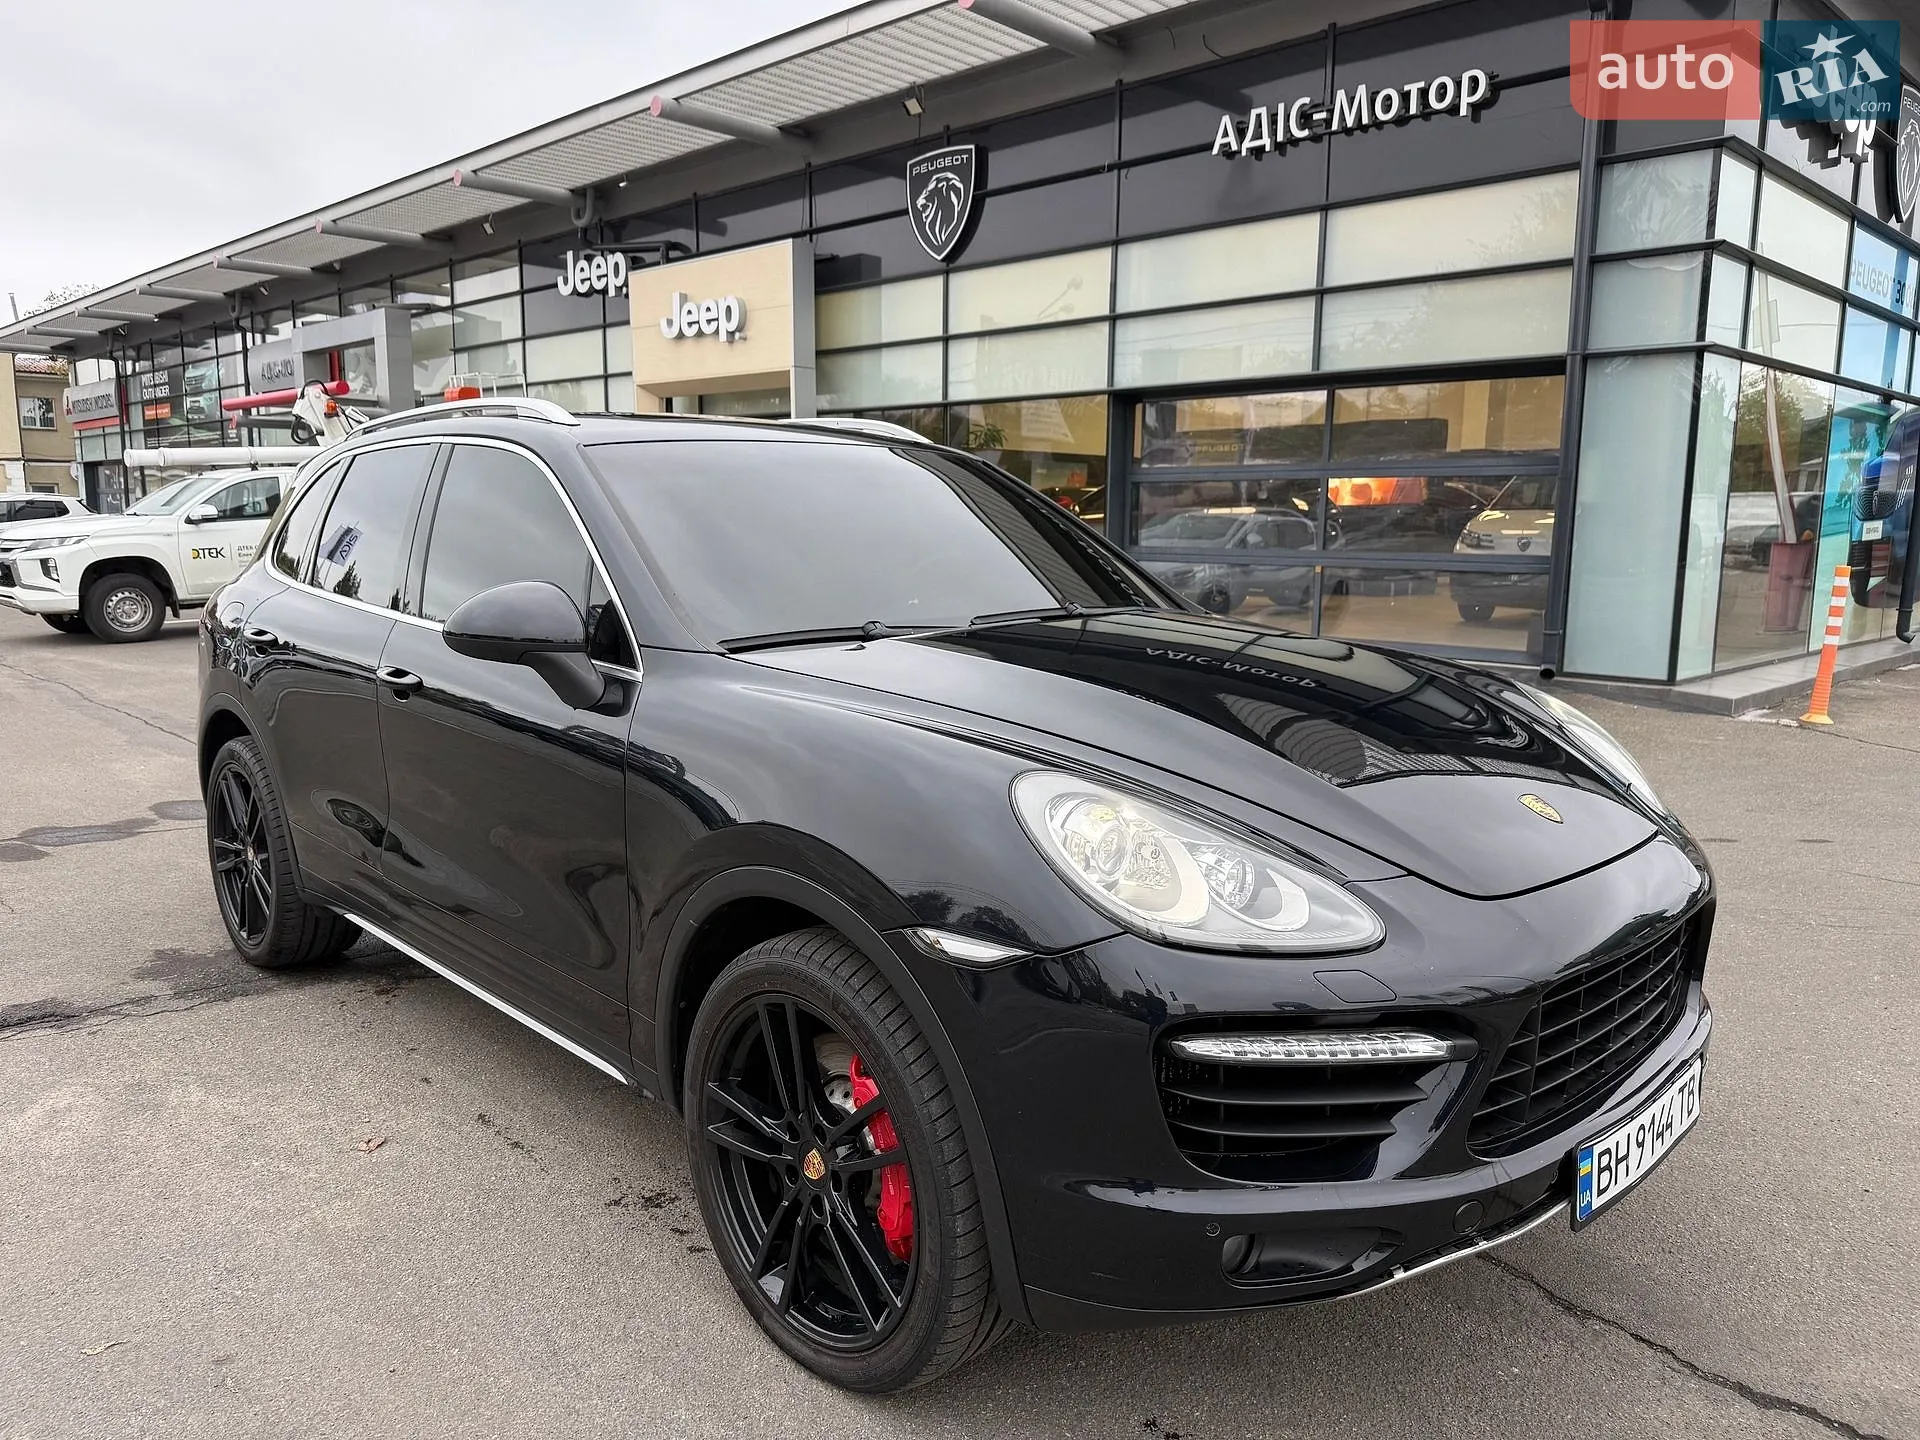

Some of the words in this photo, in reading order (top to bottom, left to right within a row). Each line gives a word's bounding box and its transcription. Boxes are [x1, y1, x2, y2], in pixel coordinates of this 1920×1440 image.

[1211, 68, 1488, 156] АДІС-Мотор
[912, 154, 969, 177] PEUGEOT
[557, 250, 627, 298] Jeep
[660, 291, 743, 342] Jeep
[1597, 1133, 1631, 1199] BH
[1636, 1095, 1674, 1171] 9144
[1678, 1073, 1695, 1126] TB
[1580, 1191, 1591, 1207] UA
